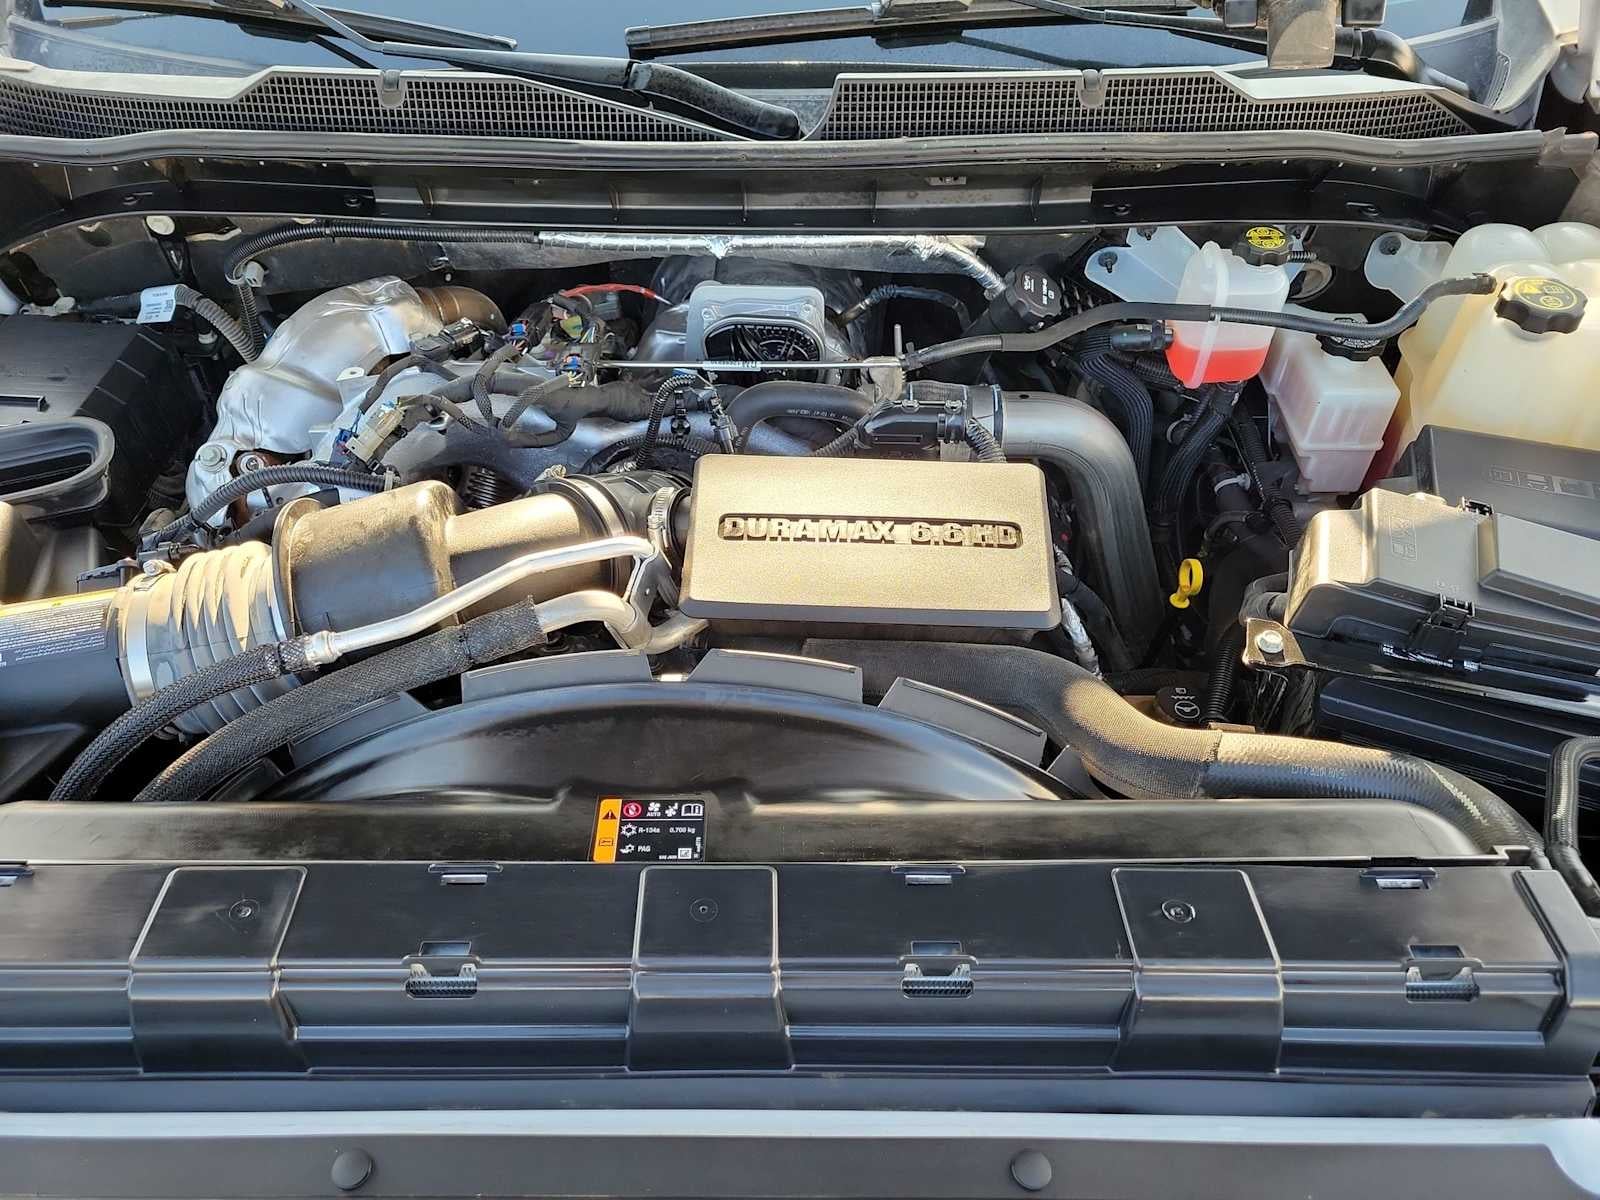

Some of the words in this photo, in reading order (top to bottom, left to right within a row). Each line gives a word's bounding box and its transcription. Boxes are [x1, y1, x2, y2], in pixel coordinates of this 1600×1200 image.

[723, 517, 895, 544] DURAMAX
[910, 521, 963, 546] 6.6
[971, 523, 1018, 549] HD
[687, 826, 696, 834] kg
